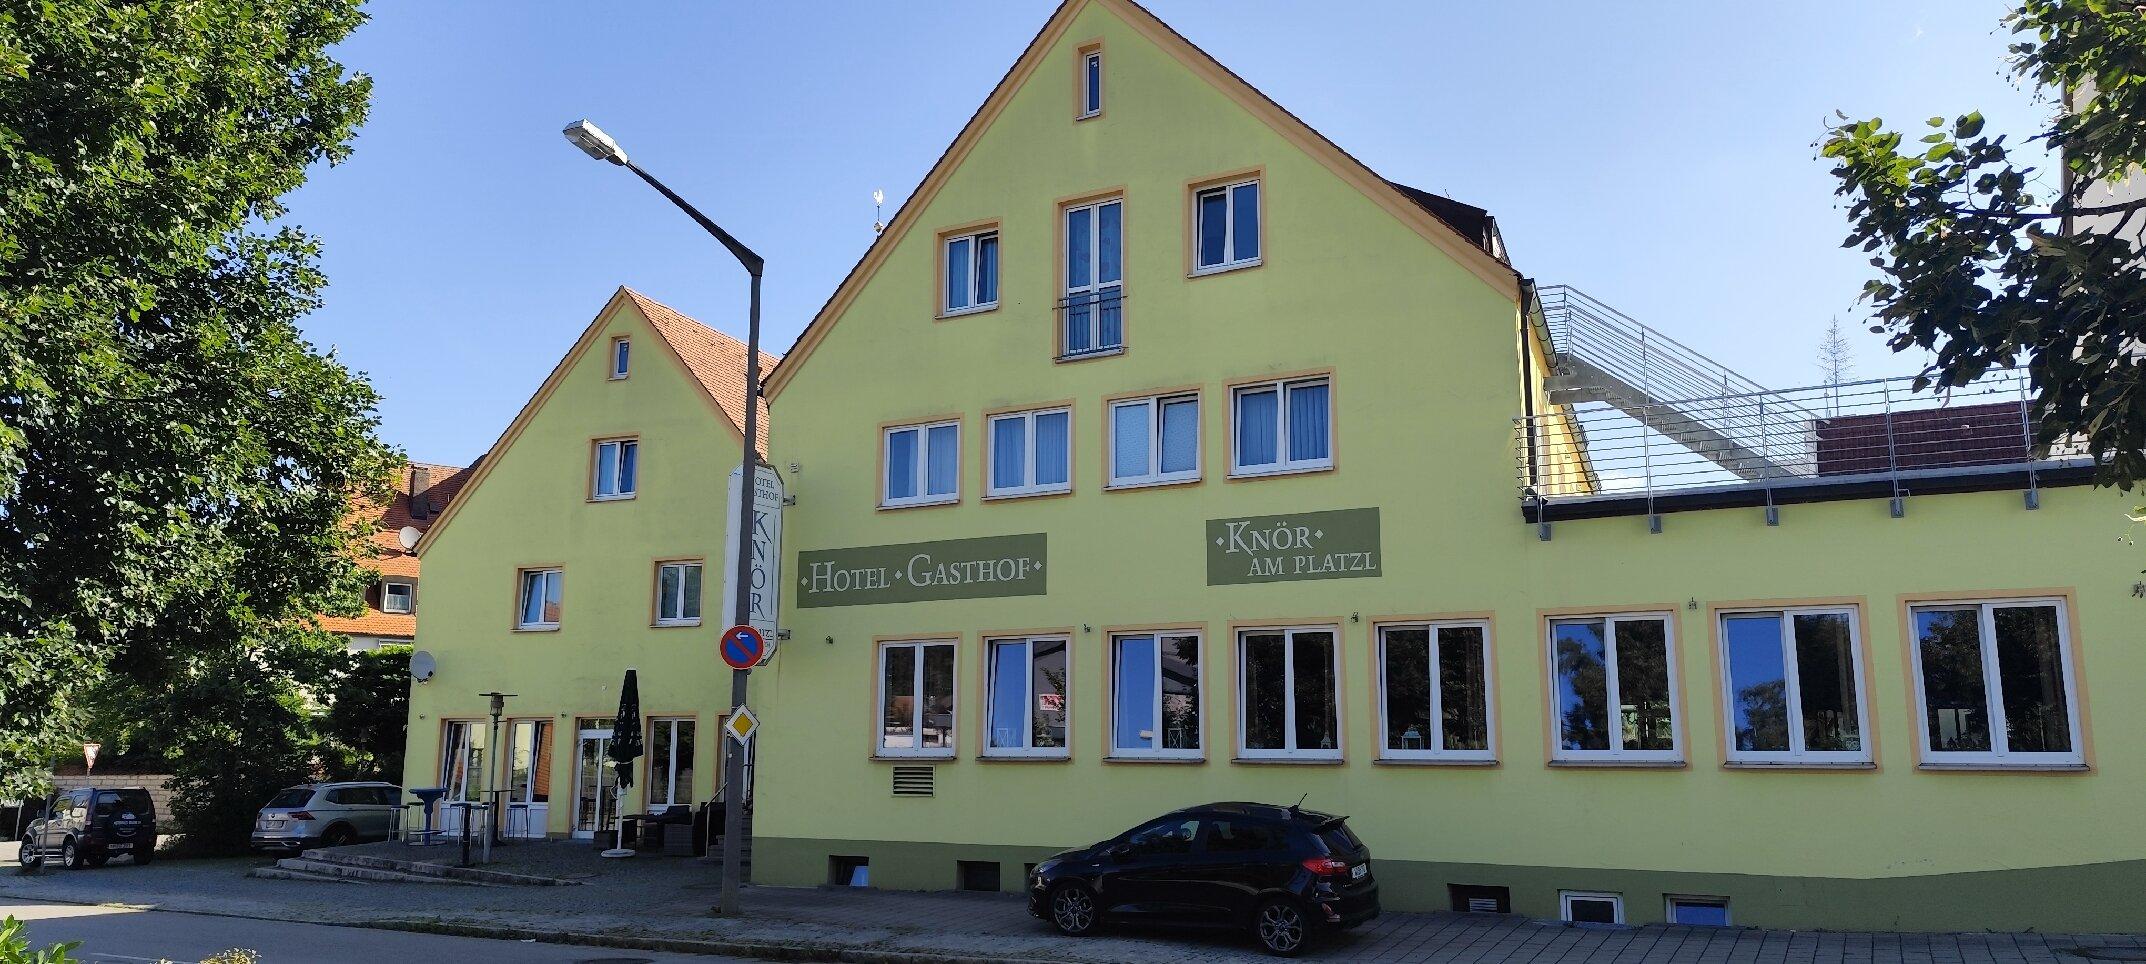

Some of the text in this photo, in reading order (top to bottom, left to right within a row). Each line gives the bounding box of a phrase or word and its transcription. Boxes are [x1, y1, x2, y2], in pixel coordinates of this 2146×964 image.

[754, 476, 774, 489] OTEL
[1225, 520, 1313, 556] KNÖR
[750, 510, 772, 619] KNÖR
[808, 553, 1030, 593] HOTEL GASTHOF
[1247, 551, 1377, 577] AM PLATZL
